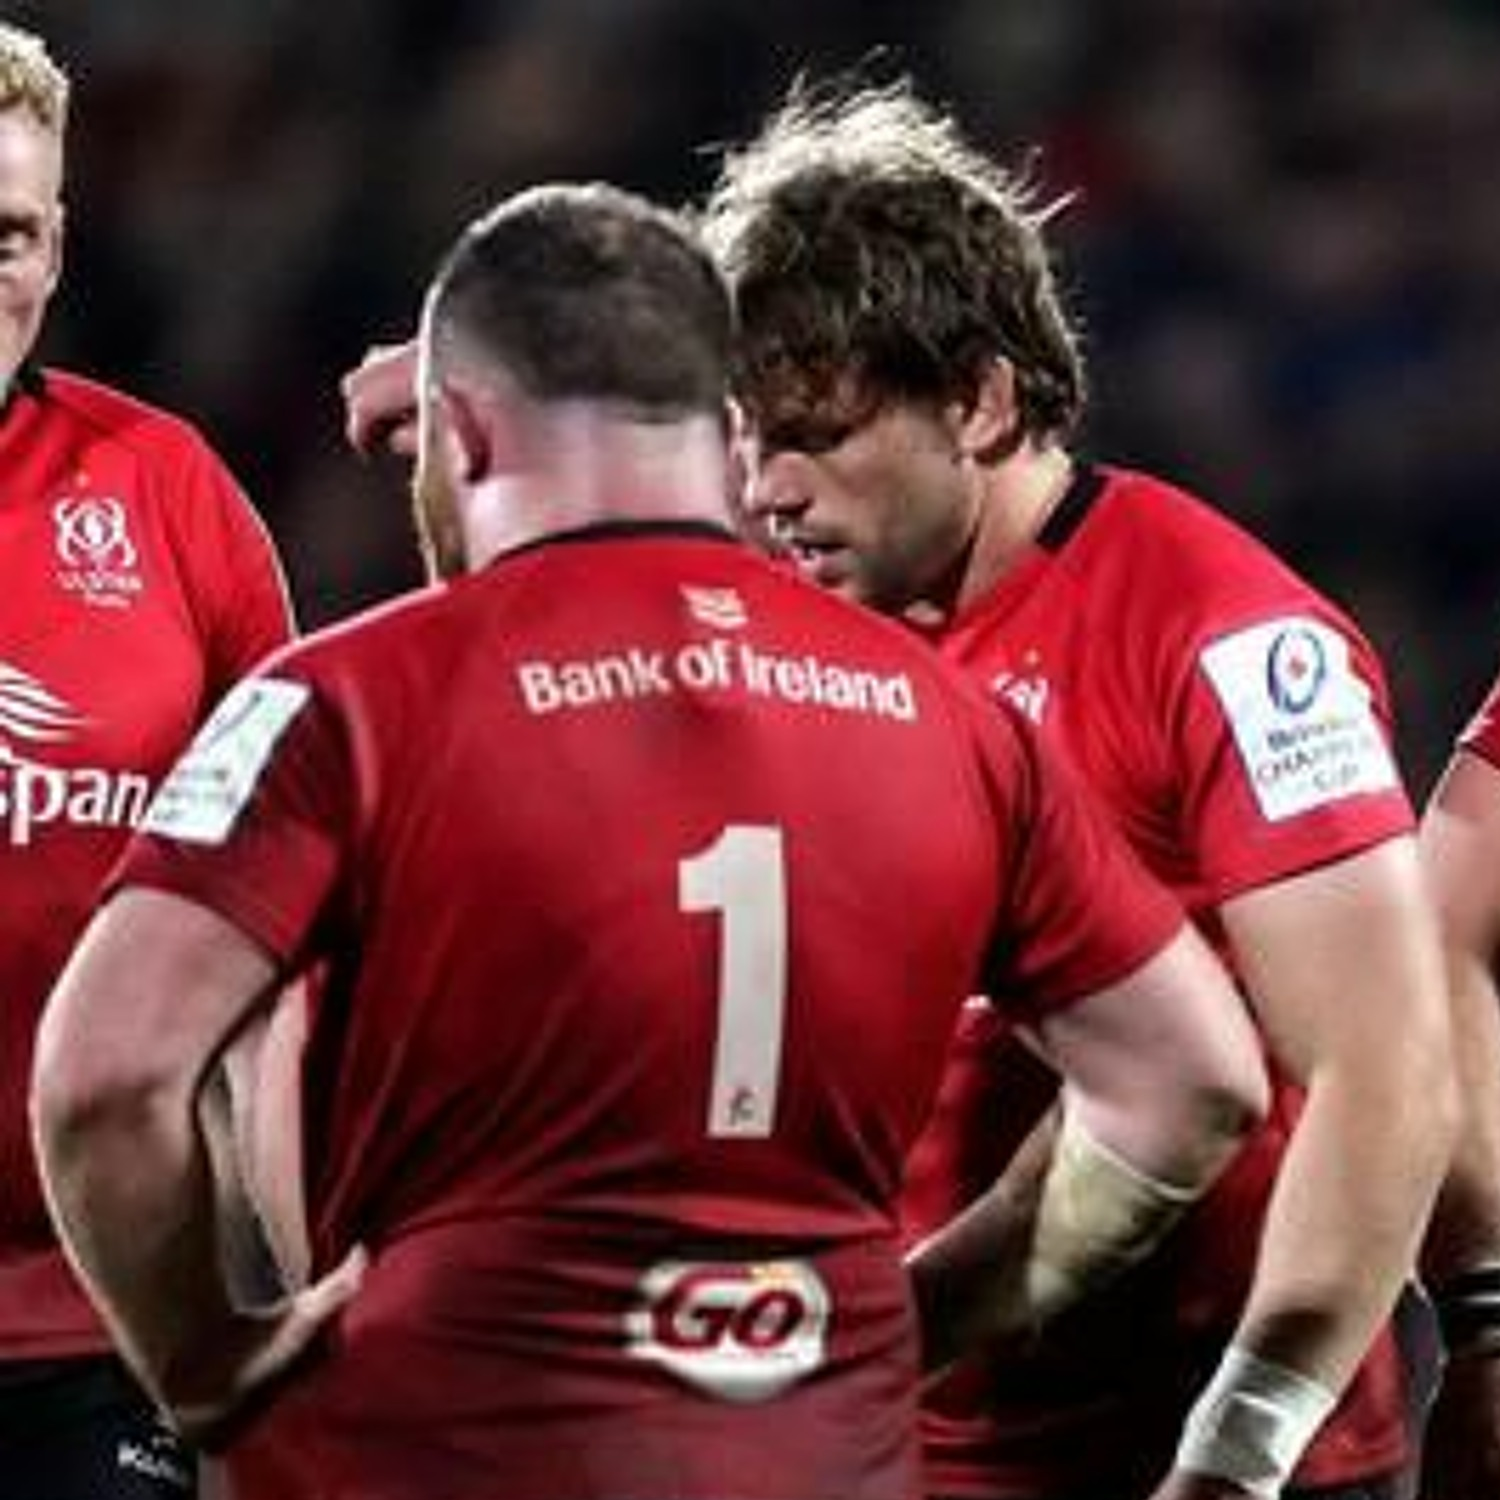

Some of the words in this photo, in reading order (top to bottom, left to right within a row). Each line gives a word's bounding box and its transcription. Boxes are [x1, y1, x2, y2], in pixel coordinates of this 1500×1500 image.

[518, 650, 671, 715] Bank
[677, 638, 734, 689] of
[740, 643, 917, 723] Ireland
[677, 825, 788, 1138] 1
